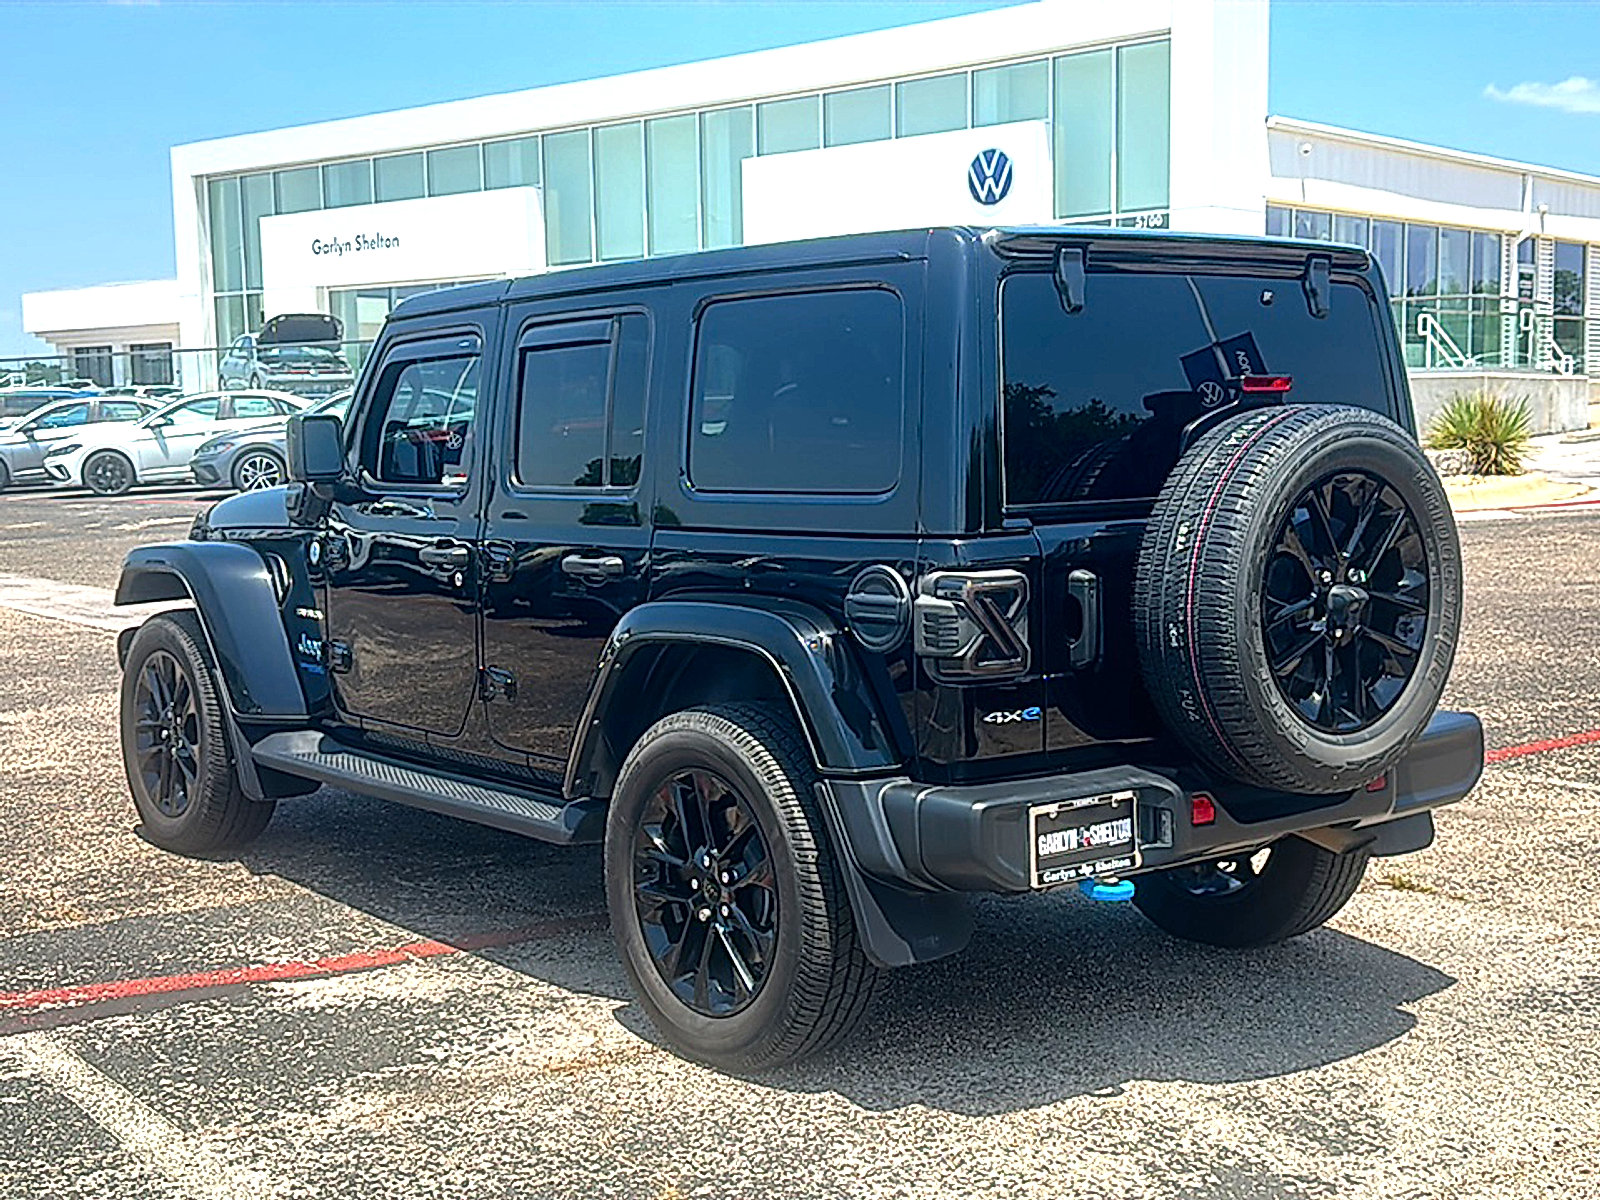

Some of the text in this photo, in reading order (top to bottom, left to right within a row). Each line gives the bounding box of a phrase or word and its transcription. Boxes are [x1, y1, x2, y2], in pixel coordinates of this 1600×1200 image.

[312, 231, 400, 256] Garlyn Shelton
[1038, 817, 1132, 856] GARLYN SHELTON
